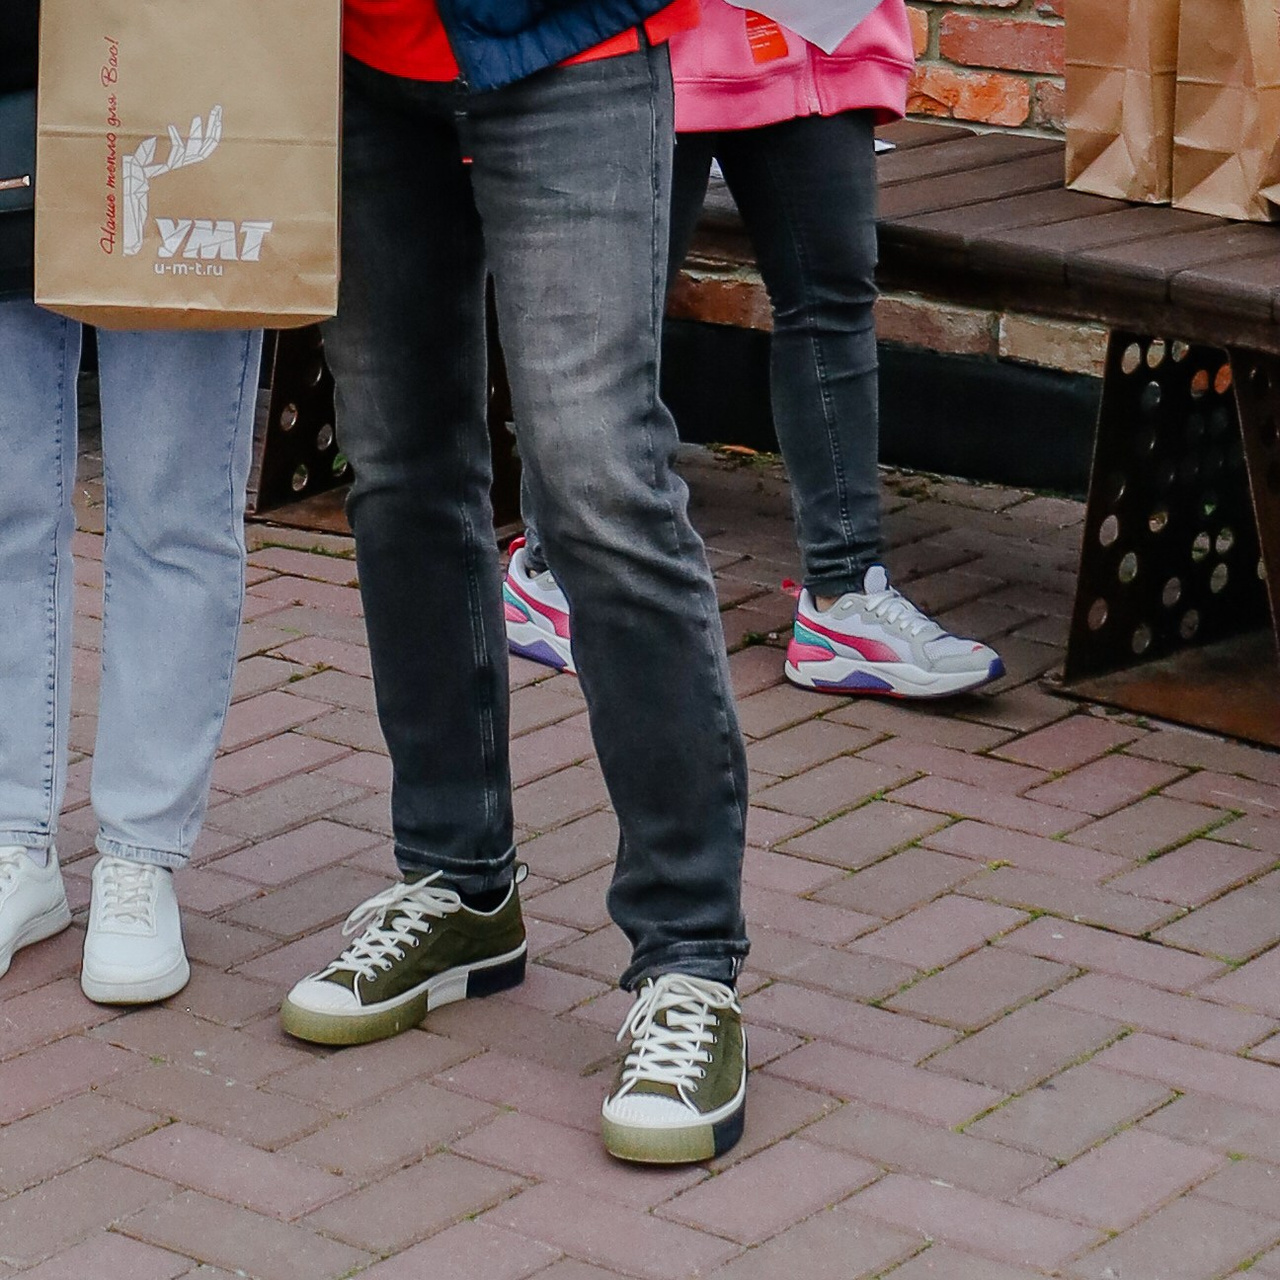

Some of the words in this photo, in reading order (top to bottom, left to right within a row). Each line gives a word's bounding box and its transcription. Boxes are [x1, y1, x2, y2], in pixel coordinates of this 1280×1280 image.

[101, 36, 119, 87] Вас!
[107, 92, 121, 128] для
[106, 132, 116, 189] тепло
[99, 193, 116, 255] Наше
[155, 218, 273, 261] УМТ
[154, 262, 224, 277] u-m-t.ru
